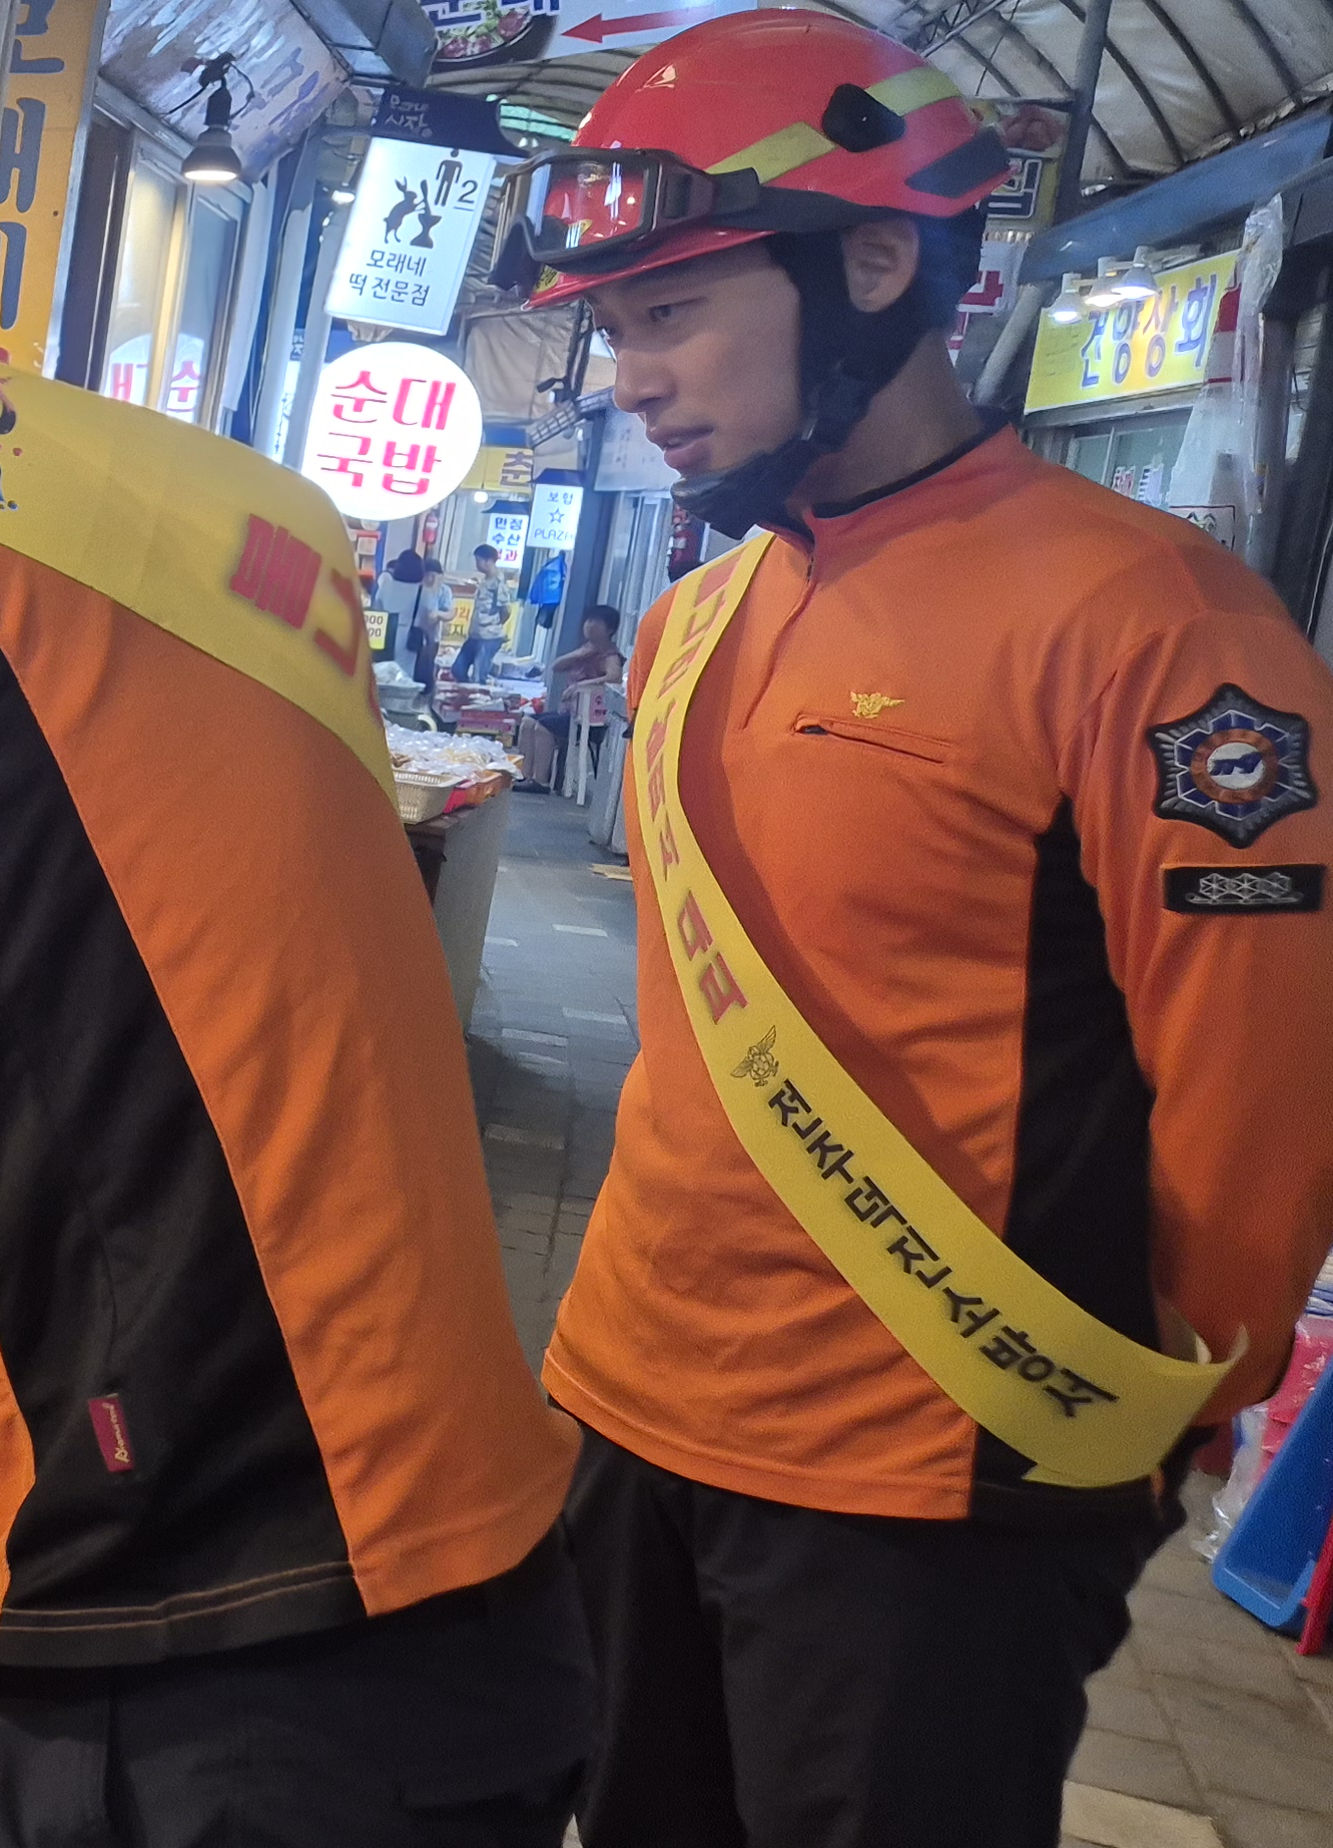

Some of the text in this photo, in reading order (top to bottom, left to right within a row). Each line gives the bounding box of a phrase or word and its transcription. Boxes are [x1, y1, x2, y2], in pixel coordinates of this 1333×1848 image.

[457, 179, 478, 204] 2
[366, 249, 427, 278] 모래네
[349, 272, 431, 307] 떡 전문점
[331, 370, 457, 431] 순대
[316, 432, 443, 495] 국밥
[491, 532, 521, 546] 수산
[769, 1079, 1119, 1419] 전주덕진소방서
